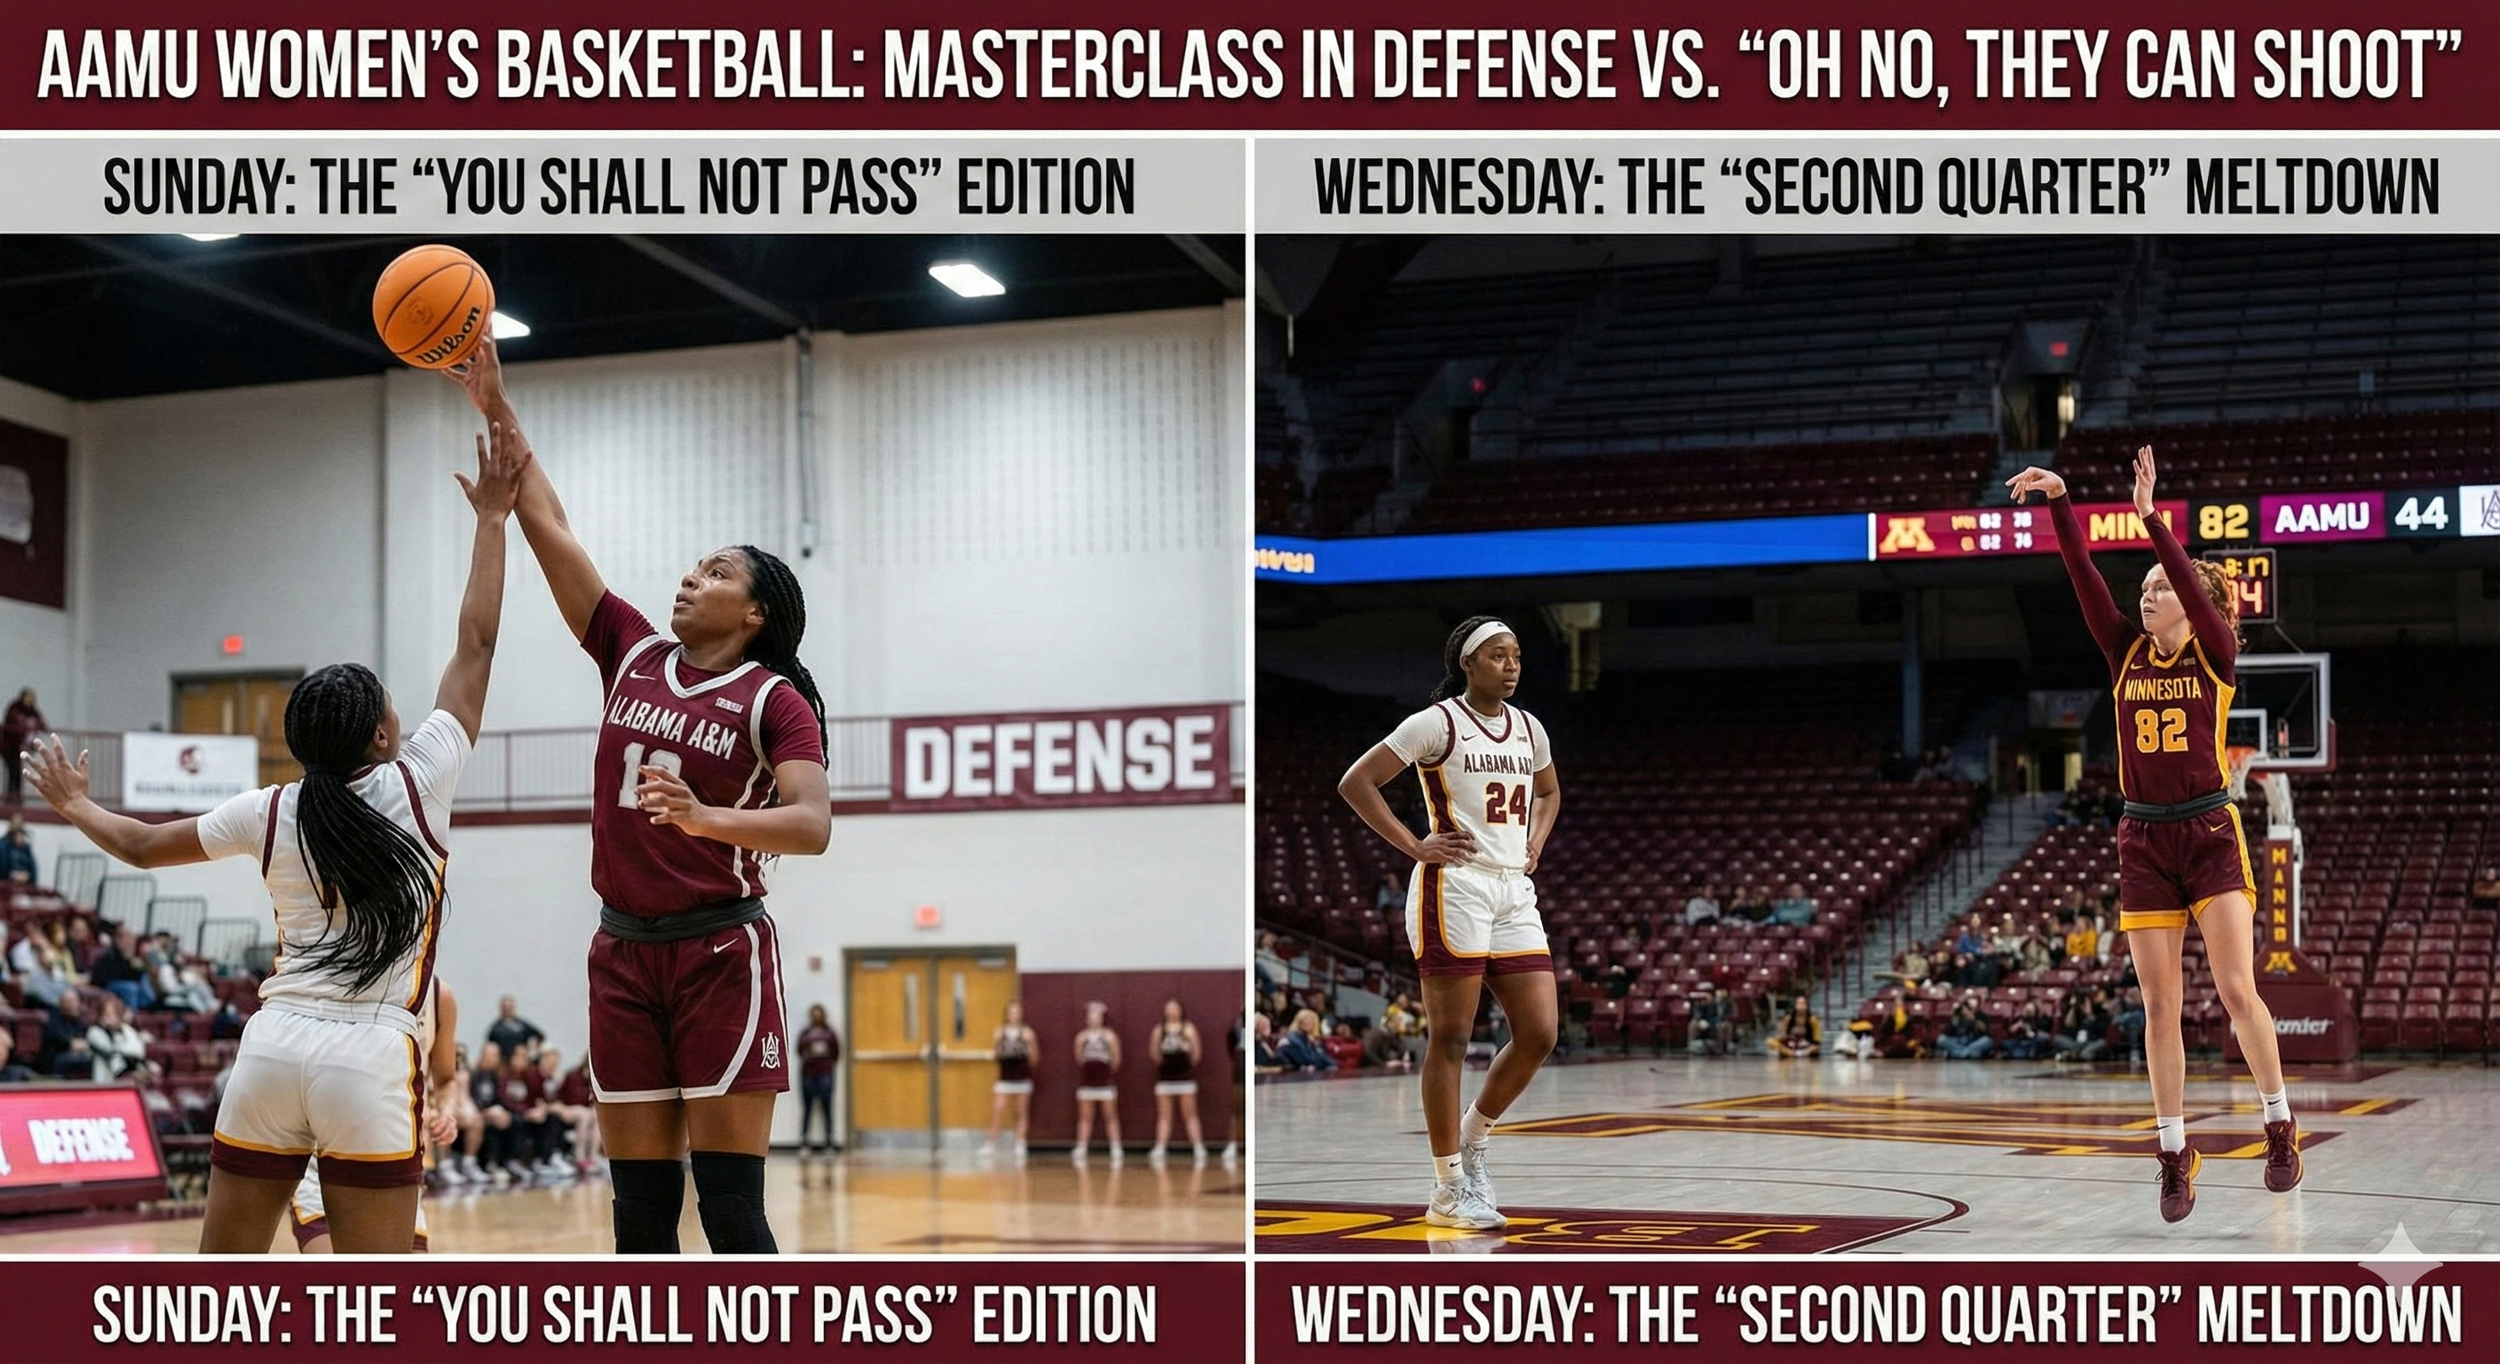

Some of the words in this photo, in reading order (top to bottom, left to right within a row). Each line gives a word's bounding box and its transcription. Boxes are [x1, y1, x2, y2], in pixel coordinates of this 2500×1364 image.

[416, 306, 480, 364] Wilson
[2199, 505, 2249, 540] 82
[2275, 502, 2369, 533] AAMU
[2395, 497, 2449, 531] 44
[2125, 677, 2202, 701] MINNESOTA
[606, 694, 688, 744] ALABAMA
[686, 719, 738, 761] A&M
[2135, 708, 2189, 754] 82
[905, 715, 1215, 800] DEFENSE
[1464, 753, 1516, 775] ALABAMA
[1486, 782, 1527, 826] 24
[27, 1117, 136, 1165] DEFENSE
